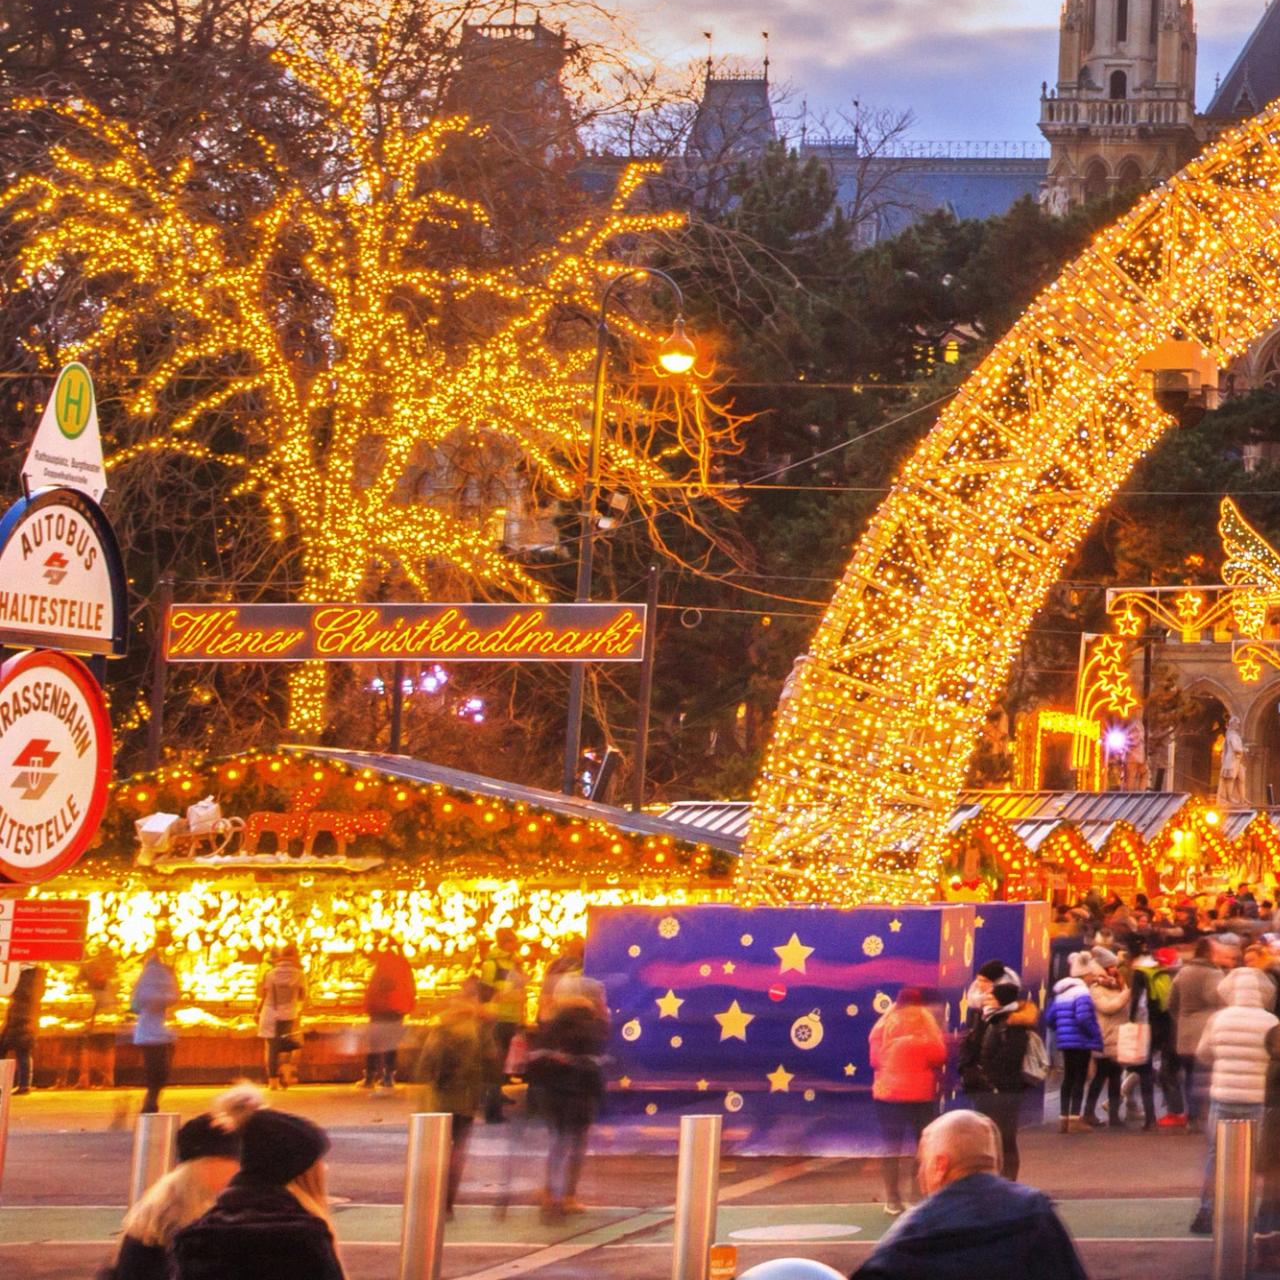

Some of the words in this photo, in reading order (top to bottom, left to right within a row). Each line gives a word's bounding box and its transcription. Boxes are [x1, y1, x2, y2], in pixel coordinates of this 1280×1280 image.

[63, 378, 84, 426] H
[21, 513, 97, 571] AUTOBUS
[0, 591, 104, 631] HALTESTELLE
[171, 610, 304, 656] Wiener
[314, 608, 643, 655] Christkindlmarkt
[0, 681, 92, 759] RASSENBAHN
[0, 793, 81, 856] LTESTELLE
